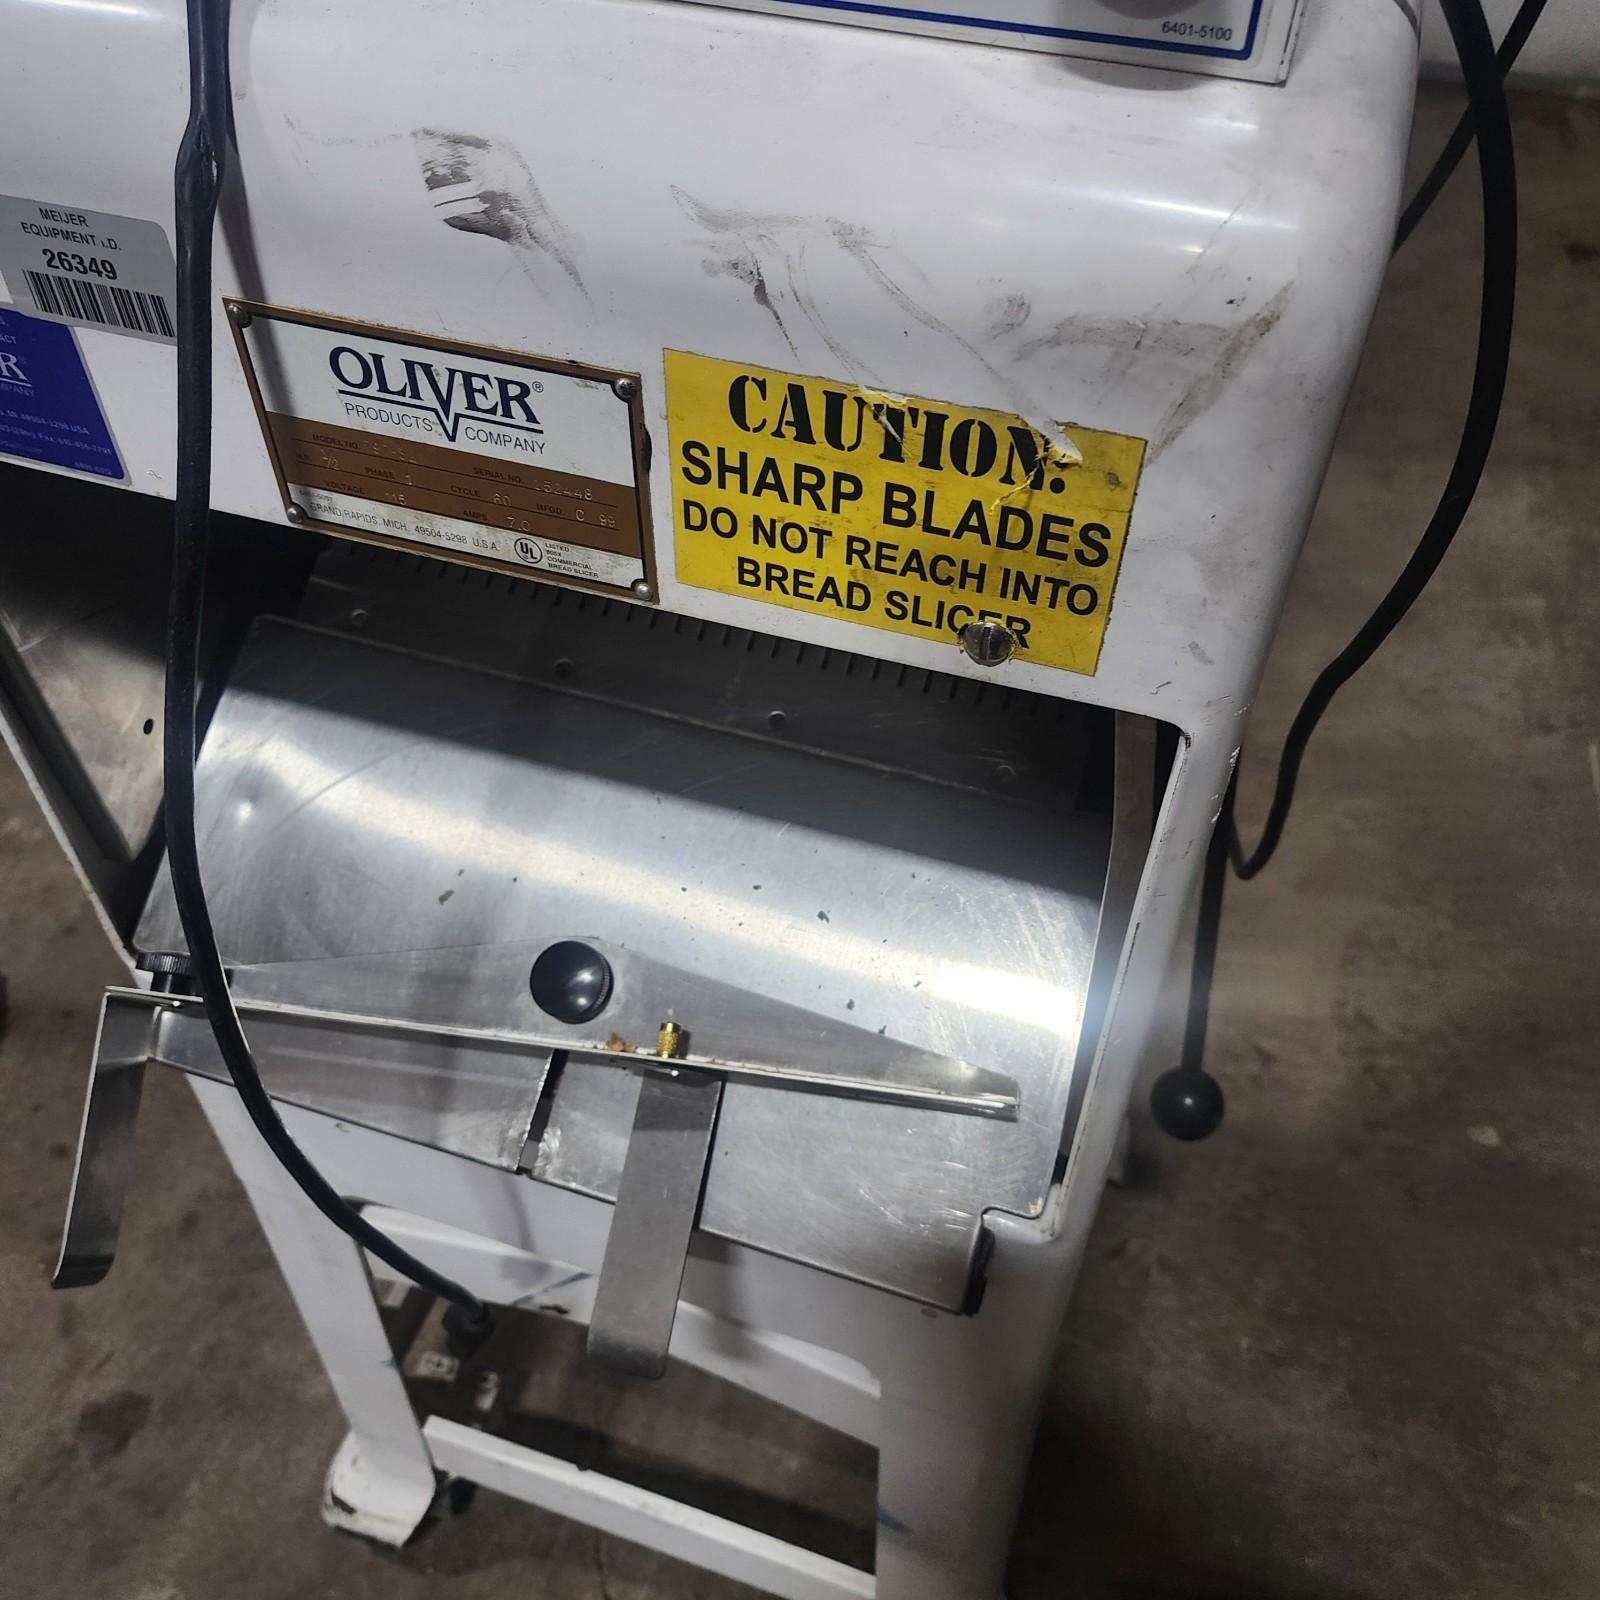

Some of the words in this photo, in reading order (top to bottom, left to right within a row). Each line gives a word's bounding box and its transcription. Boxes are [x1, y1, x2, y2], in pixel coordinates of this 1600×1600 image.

[1161, 21, 1233, 41] 6401-5100
[38, 207, 89, 227] MEIJER
[20, 221, 97, 247] EQUIPMENT
[42, 248, 118, 280] 26349
[344, 402, 433, 432] PRODUCTS
[464, 426, 546, 455] COMPANY
[312, 434, 343, 448] MODEL
[473, 467, 507, 480] SERIAL
[507, 473, 525, 484] NO.
[325, 481, 364, 495] VOLTAGE
[364, 466, 396, 480] PHASE
[450, 485, 481, 498] CYCLE
[493, 492, 511, 507] 60
[536, 503, 566, 517] MFGD.
[598, 513, 616, 528] 99
[681, 440, 863, 515] SHARP
[882, 481, 1112, 568] BLADES
[414, 524, 468, 545] 49504-5298
[545, 542, 570, 552] LISTED
[547, 555, 594, 571] COMMERCIAL
[548, 562, 573, 574] BREAD
[573, 567, 600, 579] SLICER
[683, 498, 738, 539] DO
[752, 515, 832, 560] NOT
[845, 535, 986, 594] REACH
[1000, 567, 1098, 617] INTO
[737, 556, 871, 612] BREAD
